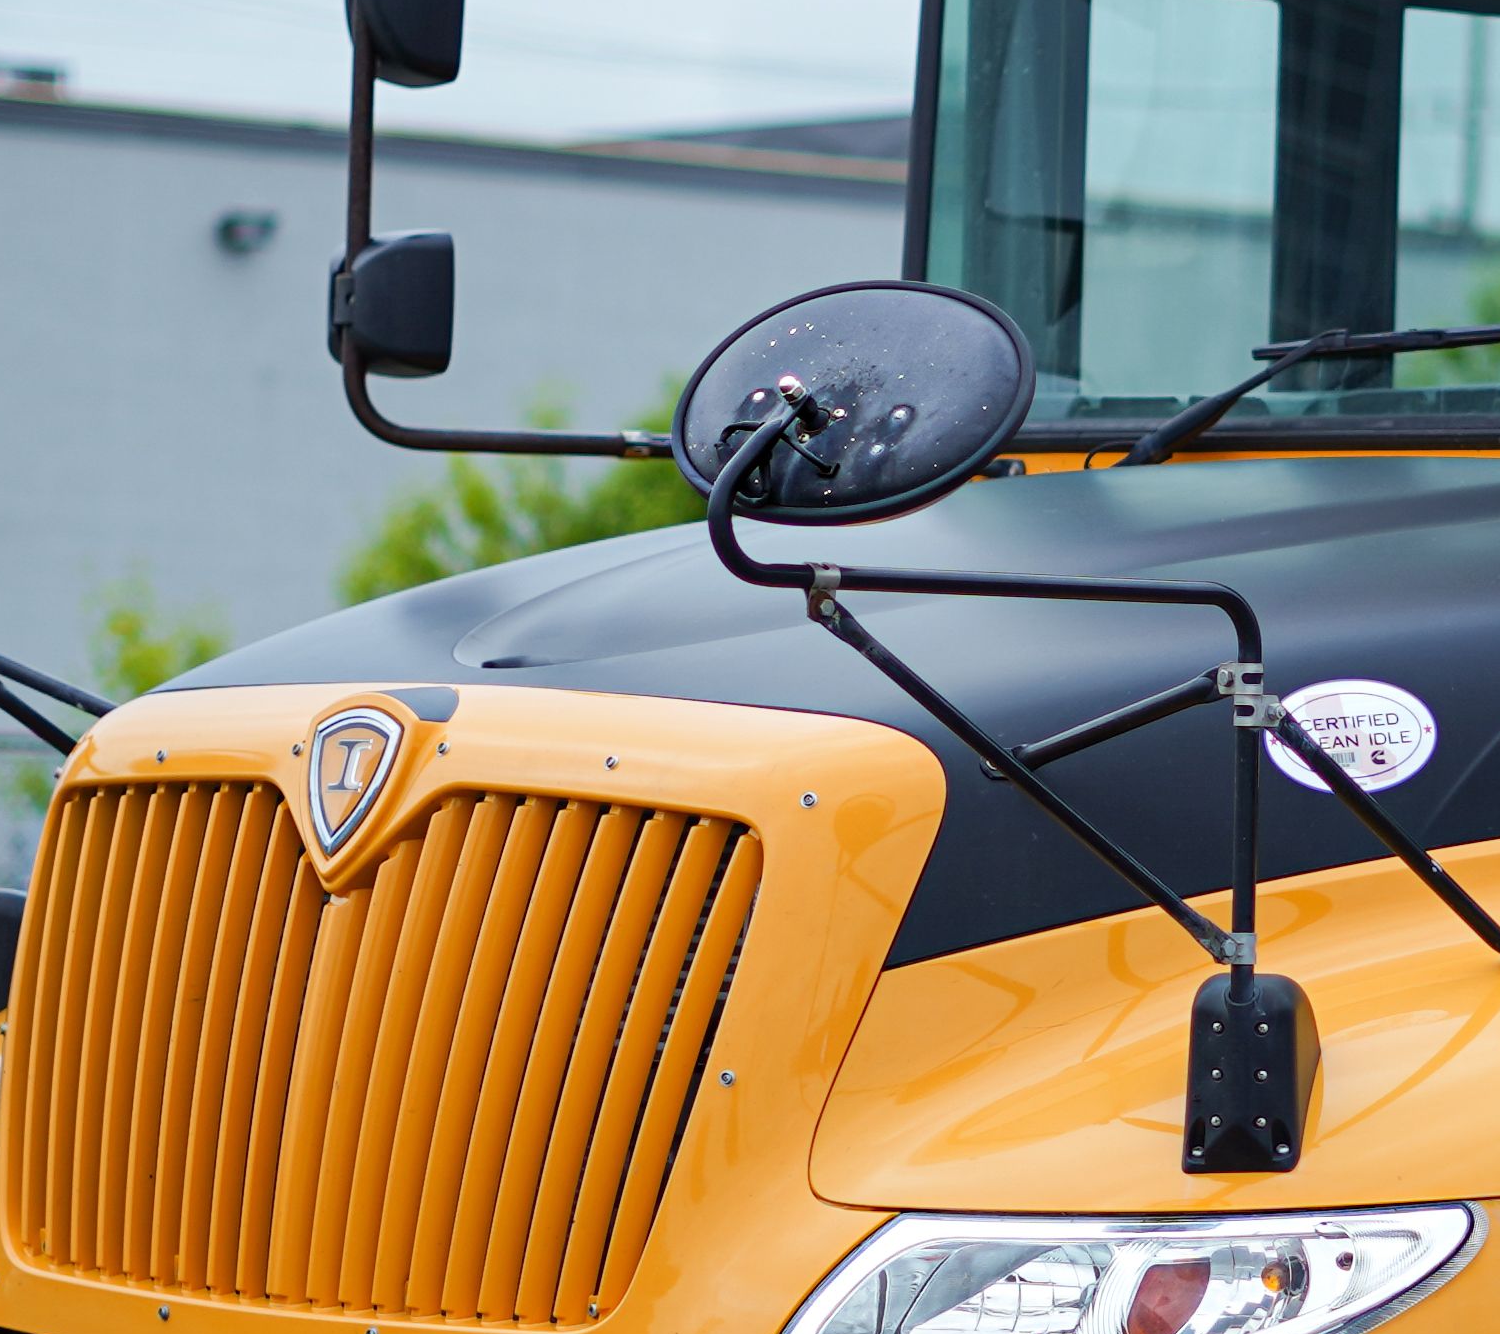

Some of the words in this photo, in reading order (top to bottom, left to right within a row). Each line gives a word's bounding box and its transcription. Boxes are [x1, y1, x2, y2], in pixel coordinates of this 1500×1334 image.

[1300, 713, 1399, 732] CERTIFIED
[1319, 734, 1359, 750] EAN
[1369, 730, 1412, 747] IDLE
